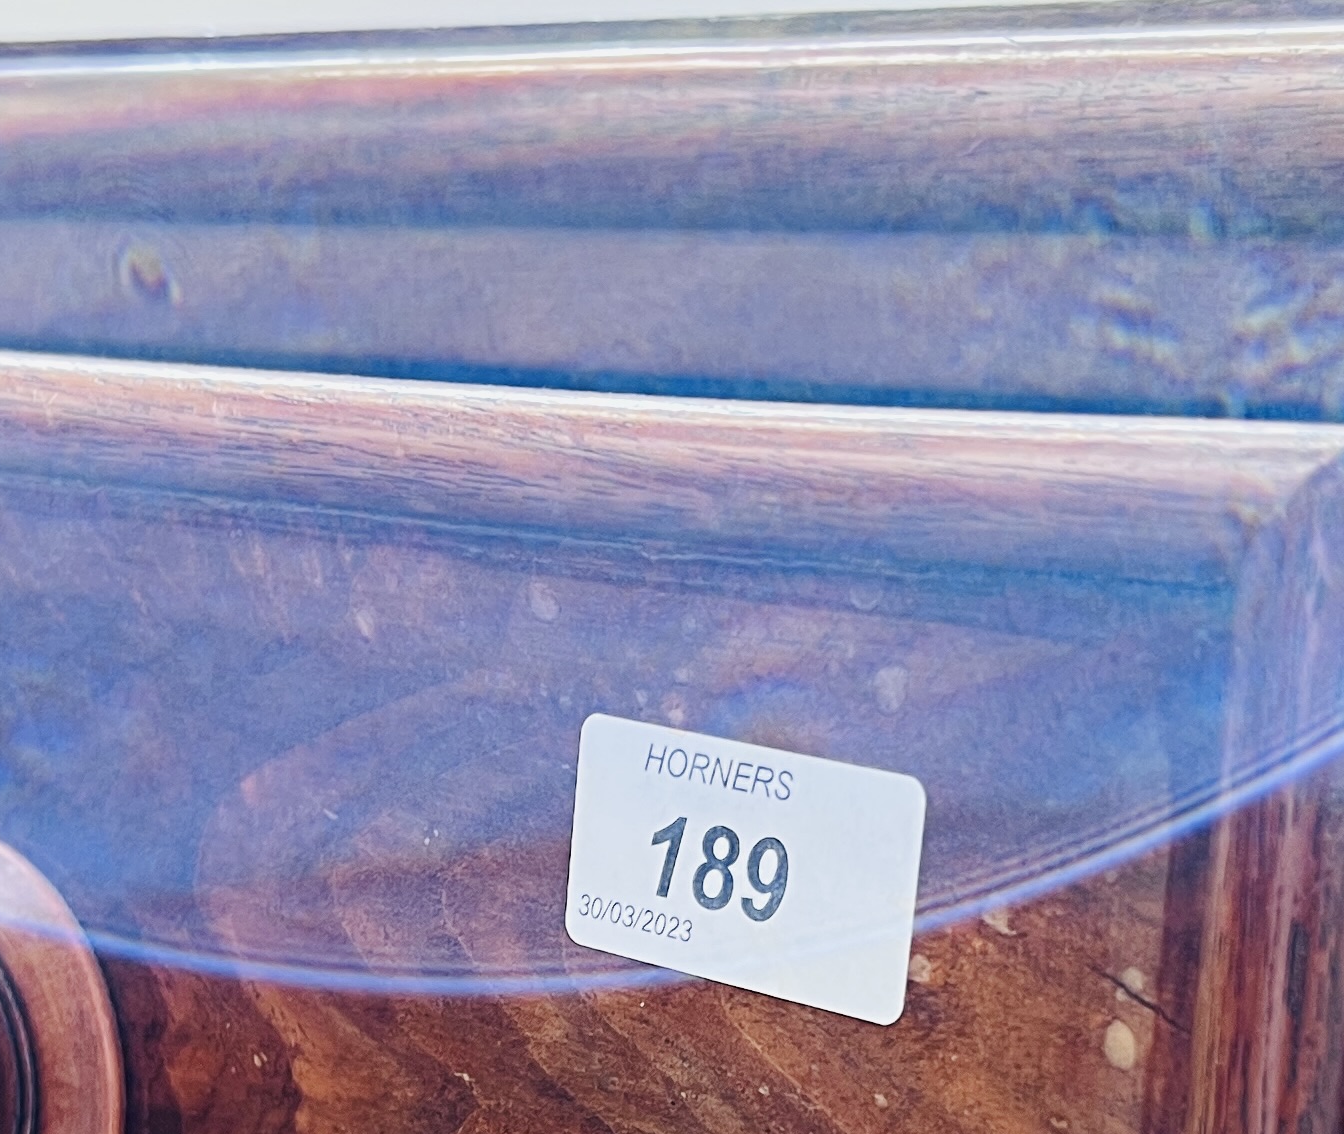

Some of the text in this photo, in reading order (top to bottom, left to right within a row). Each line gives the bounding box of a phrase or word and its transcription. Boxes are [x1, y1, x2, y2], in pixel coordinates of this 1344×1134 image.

[644, 743, 794, 801] HORNERS
[651, 816, 789, 922] 189
[578, 894, 693, 942] 30/03/2023
